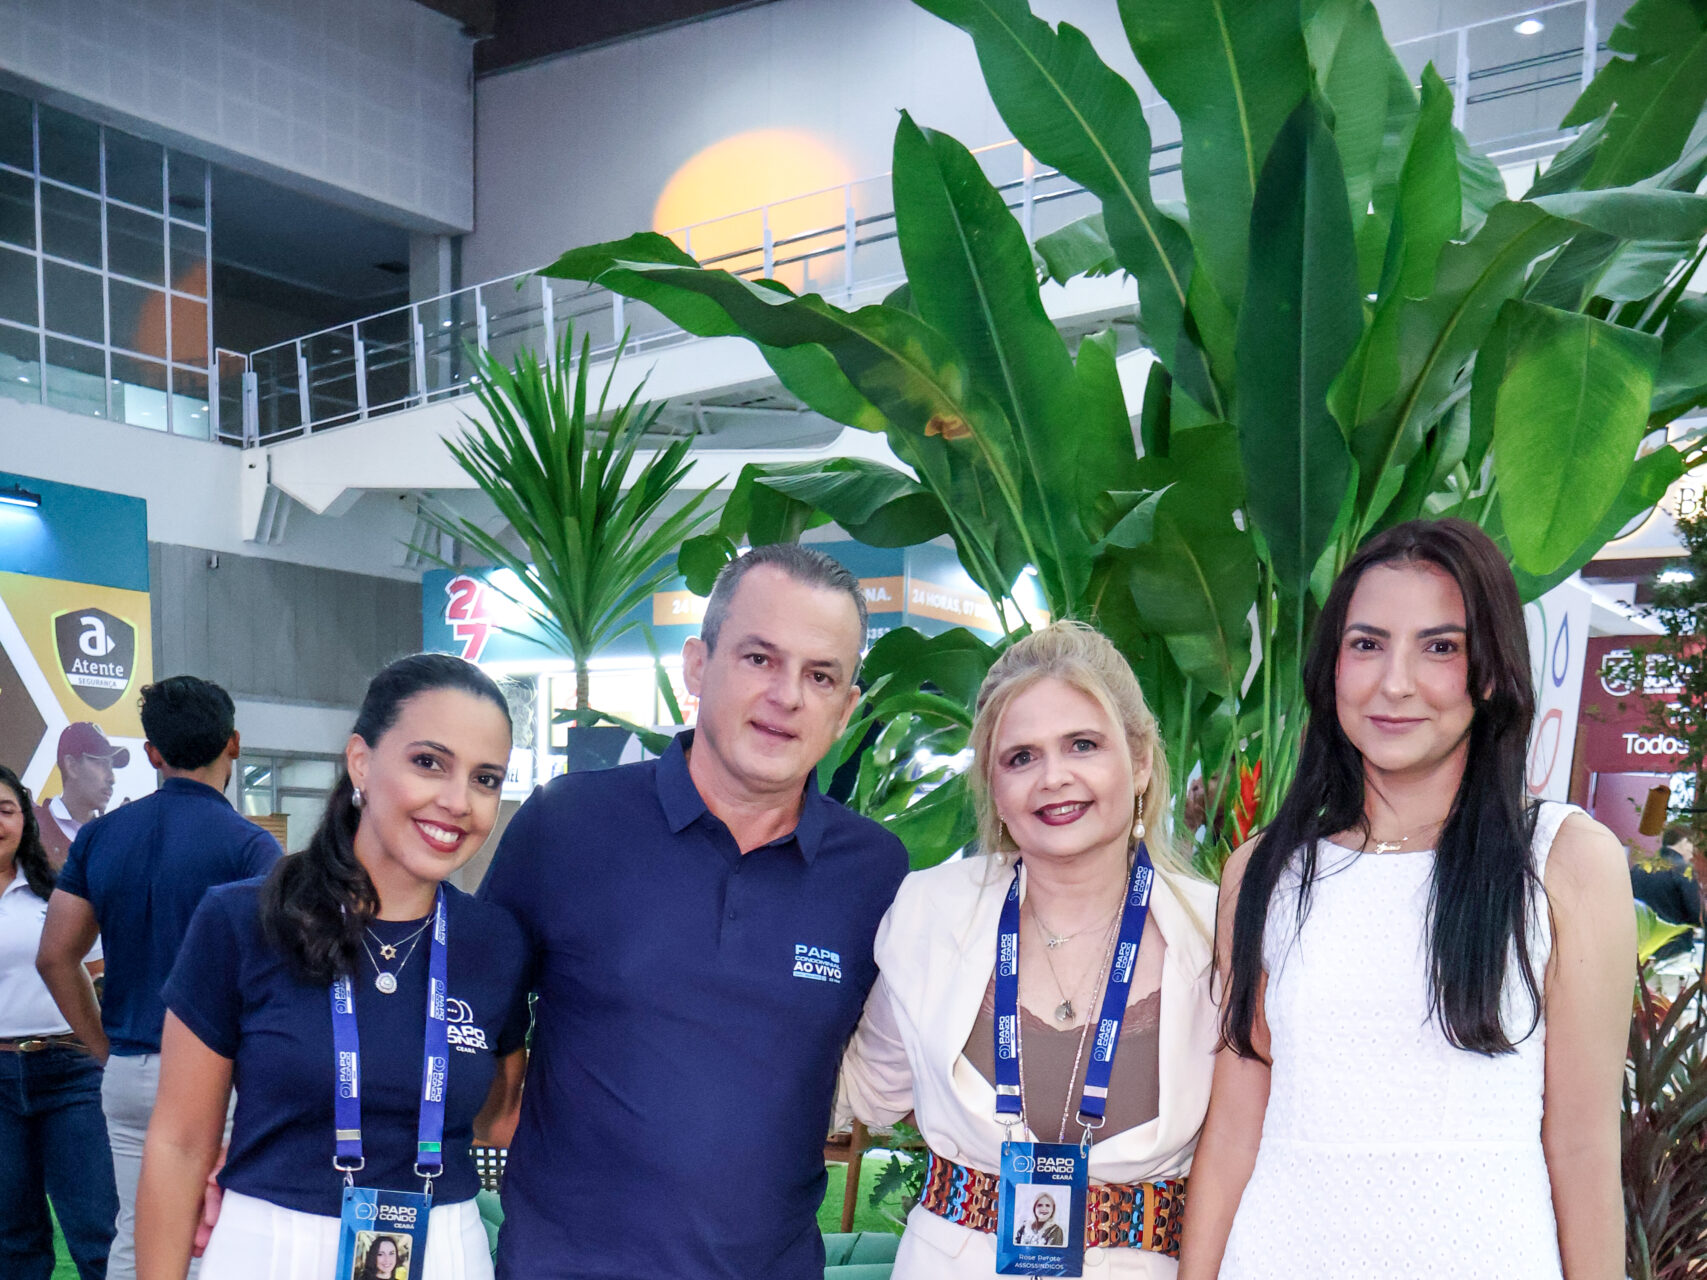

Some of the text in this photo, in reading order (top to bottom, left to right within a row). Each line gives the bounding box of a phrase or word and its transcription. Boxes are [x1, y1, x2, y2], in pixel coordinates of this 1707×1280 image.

[455, 622, 489, 661] 7
[71, 658, 124, 677] Atente
[78, 677, 117, 688] SEGURANÇA
[1622, 732, 1690, 755] Todos
[1133, 866, 1144, 892] PAPO
[1139, 867, 1149, 892] CONDO
[795, 944, 840, 963] PAPO
[1000, 934, 1008, 962] PAPO
[1115, 942, 1127, 968] PAPO
[1121, 943, 1132, 969] CONDO
[793, 961, 813, 973] AO
[815, 964, 842, 979] VIVO
[447, 1025, 485, 1042] APO
[1097, 1019, 1108, 1046] PAPO
[1102, 1019, 1113, 1047] CONDO
[430, 1072, 438, 1102] CONDO
[435, 1072, 444, 1102] PAPO
[1036, 1165, 1074, 1174] CONDO
[1037, 1157, 1075, 1167] PAPO
[379, 1213, 417, 1223] CONDO
[380, 1205, 418, 1216] PAPO
